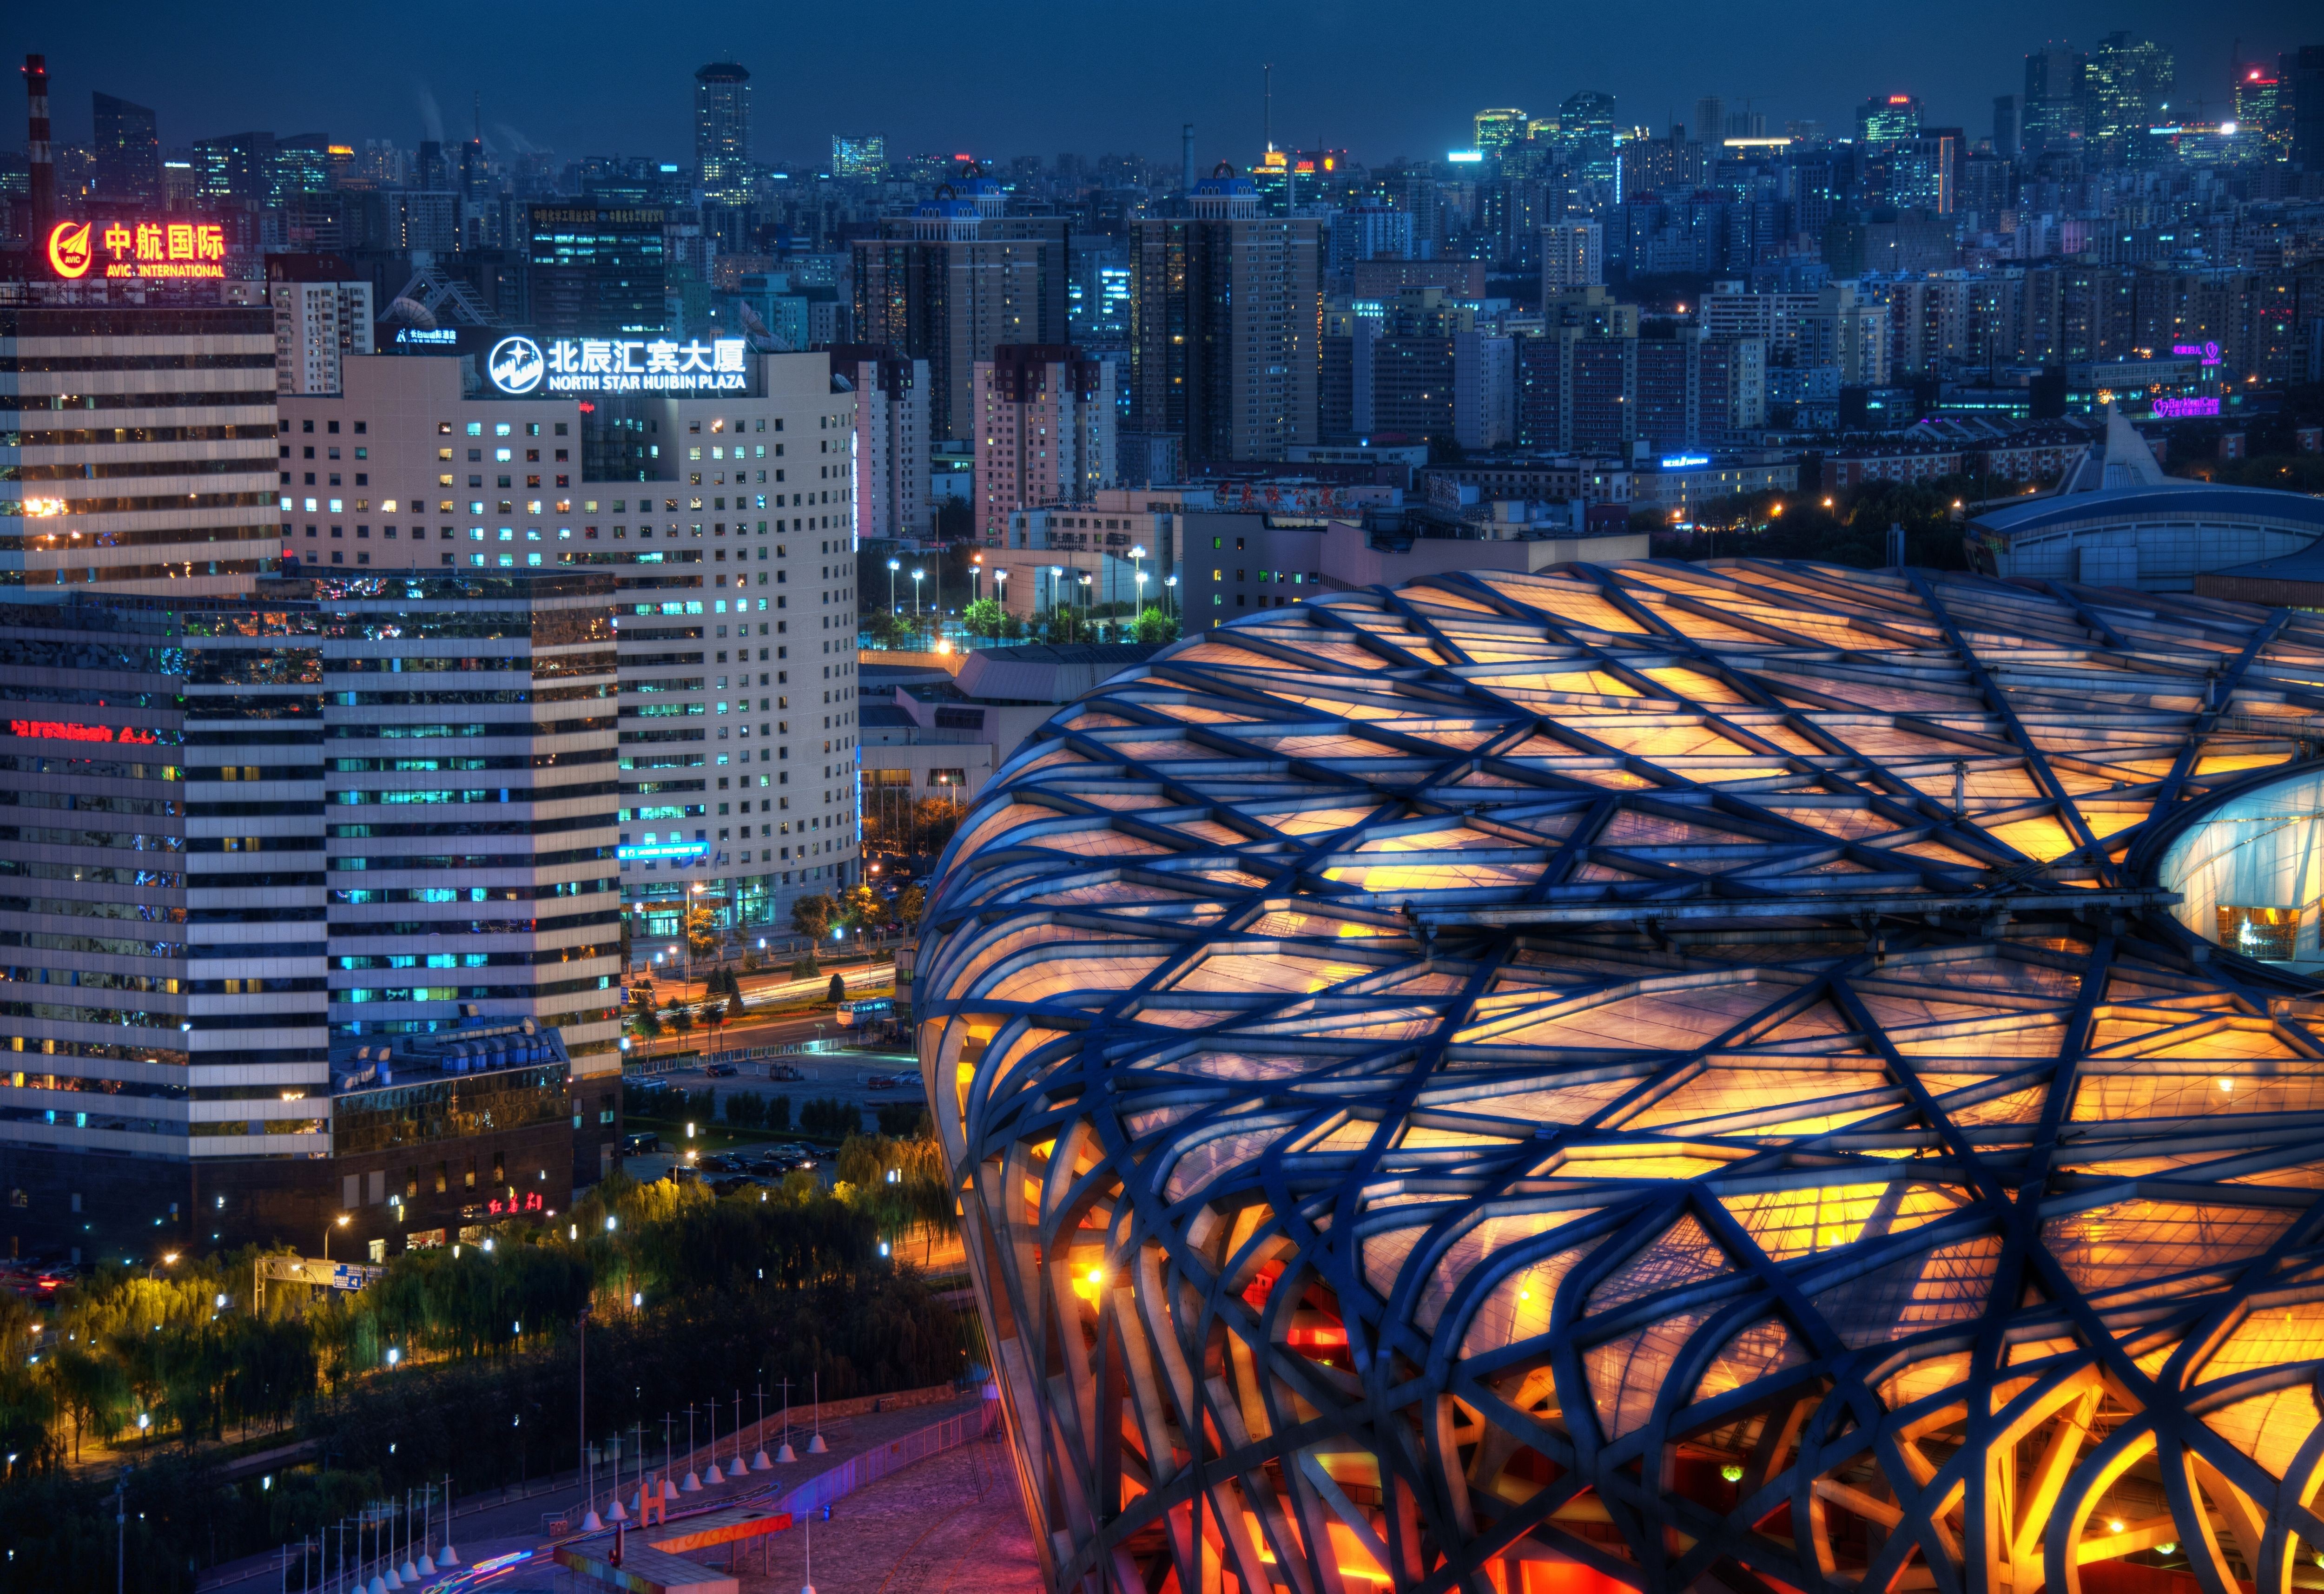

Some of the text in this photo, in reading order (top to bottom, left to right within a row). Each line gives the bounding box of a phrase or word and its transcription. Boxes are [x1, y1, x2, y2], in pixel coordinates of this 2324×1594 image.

[105, 222, 225, 261] 中航国际
[65, 256, 81, 264] AVIC
[106, 263, 225, 278] AVIC INTERNATIONAL
[548, 339, 746, 373] 北辰汇宾大厦
[549, 375, 746, 390] NORTH STAR HUIBIN PLAZA
[639, 1479, 666, 1528] H
